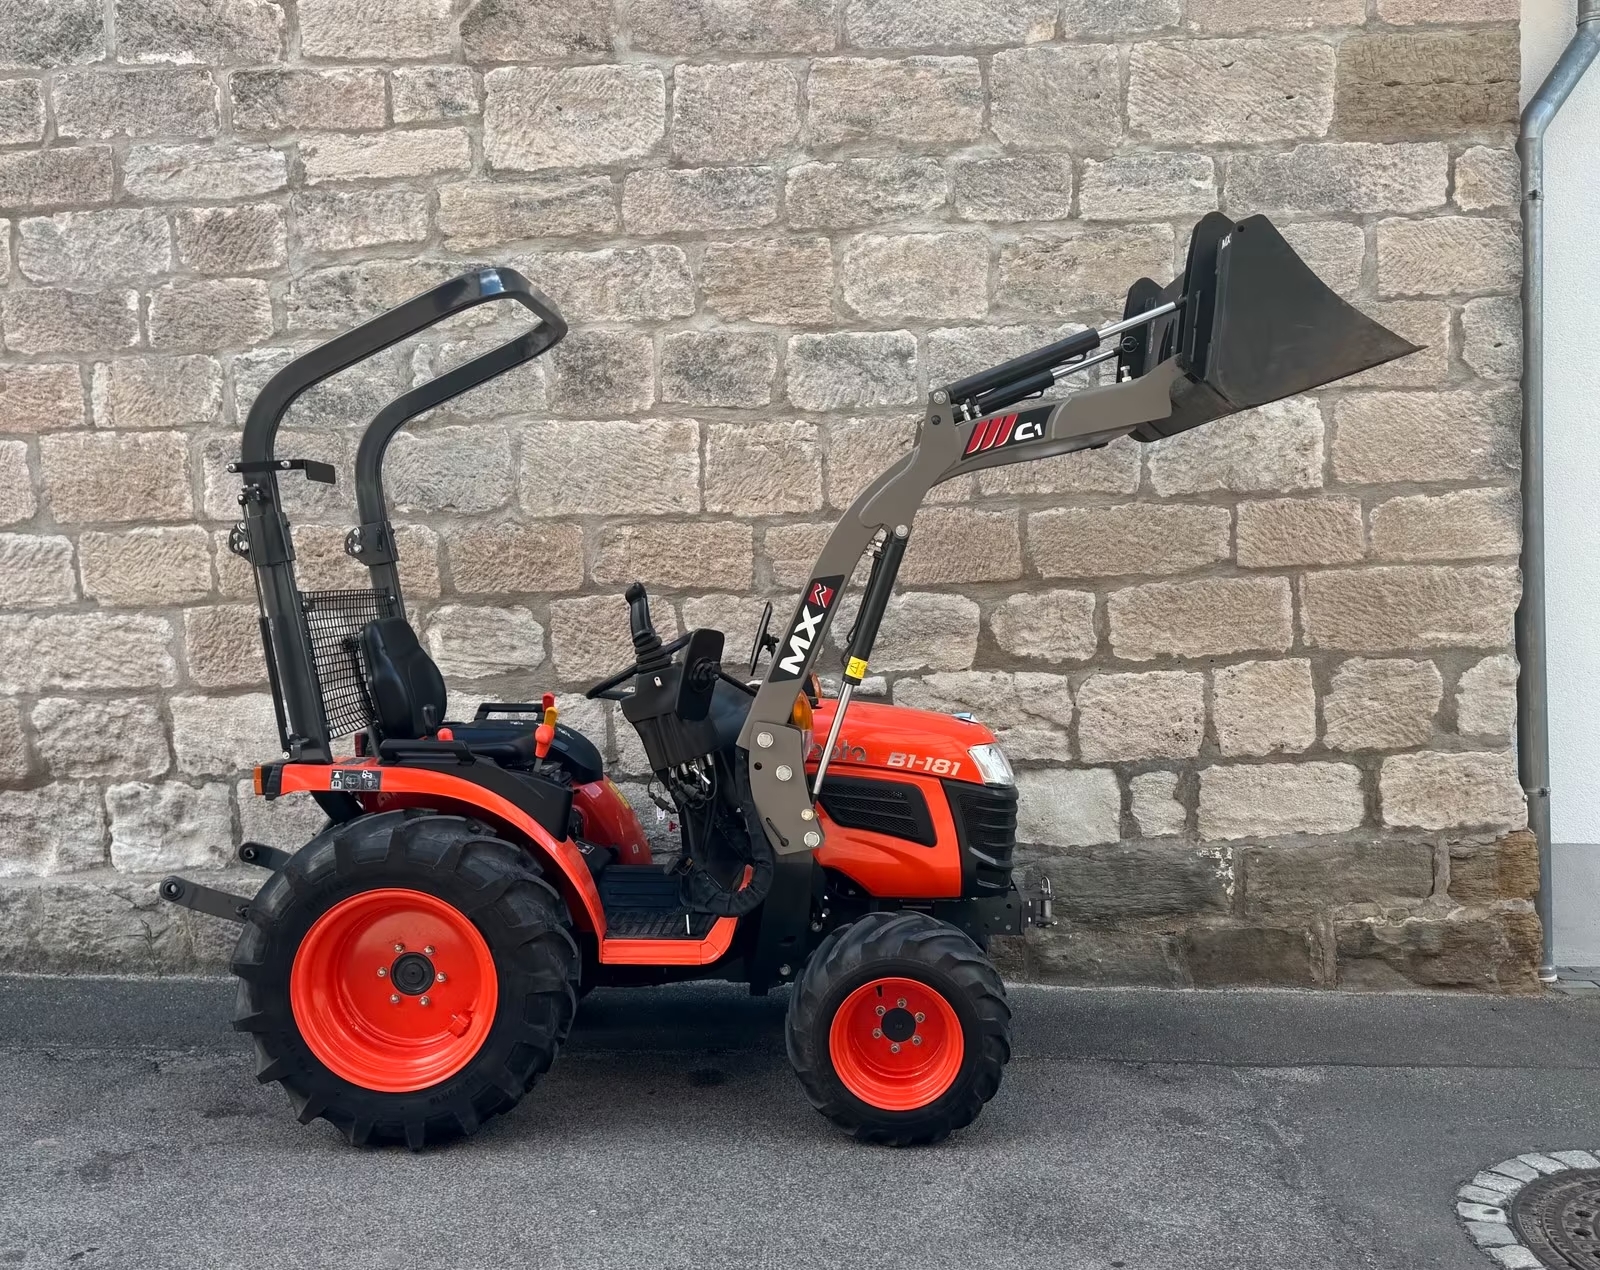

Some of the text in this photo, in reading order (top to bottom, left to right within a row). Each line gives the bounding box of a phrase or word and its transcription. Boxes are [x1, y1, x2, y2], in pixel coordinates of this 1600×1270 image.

[1014, 422, 1042, 440] C1
[779, 604, 825, 675] MX
[887, 752, 962, 777] B1-181
